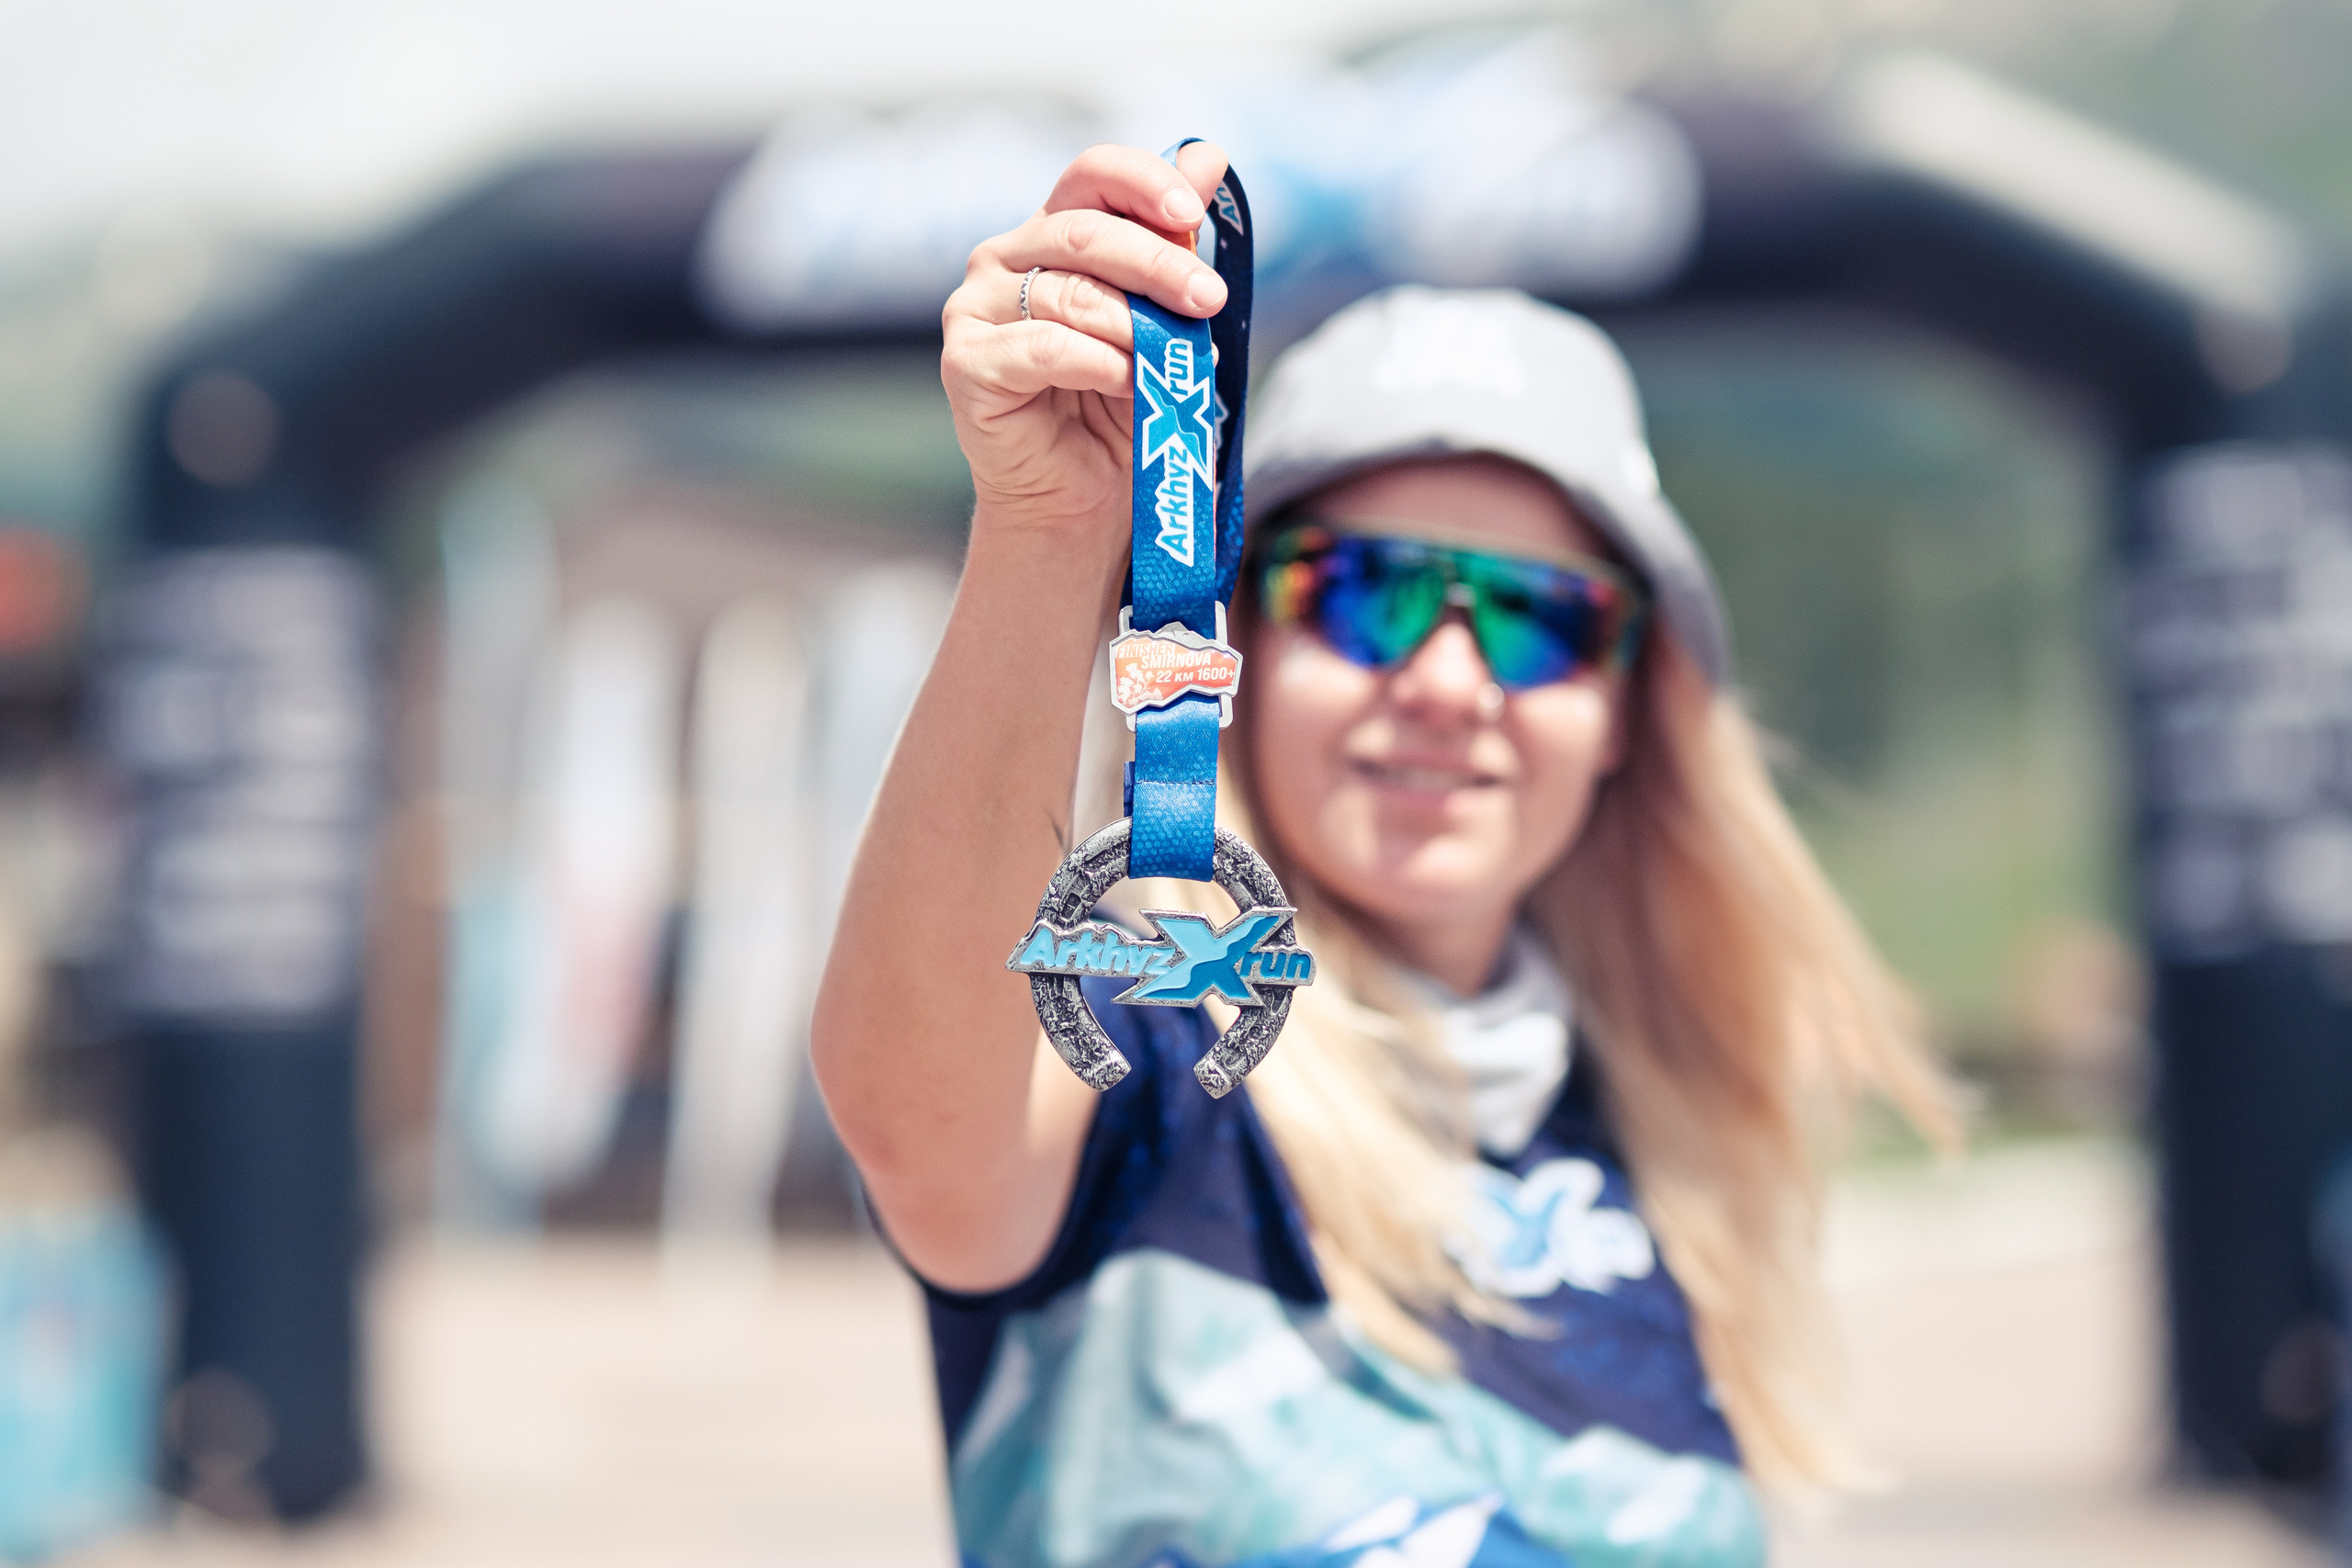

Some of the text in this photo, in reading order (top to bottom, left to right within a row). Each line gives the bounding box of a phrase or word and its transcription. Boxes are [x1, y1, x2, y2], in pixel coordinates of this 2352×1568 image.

[1159, 446, 1192, 558] Arkhyz
[1117, 644, 1173, 658] FINISHER
[1141, 652, 1211, 669] SMIRNOVA
[1156, 671, 1172, 682] 22
[1197, 668, 1235, 681] 1600+
[1020, 928, 1176, 976] Arkhyz
